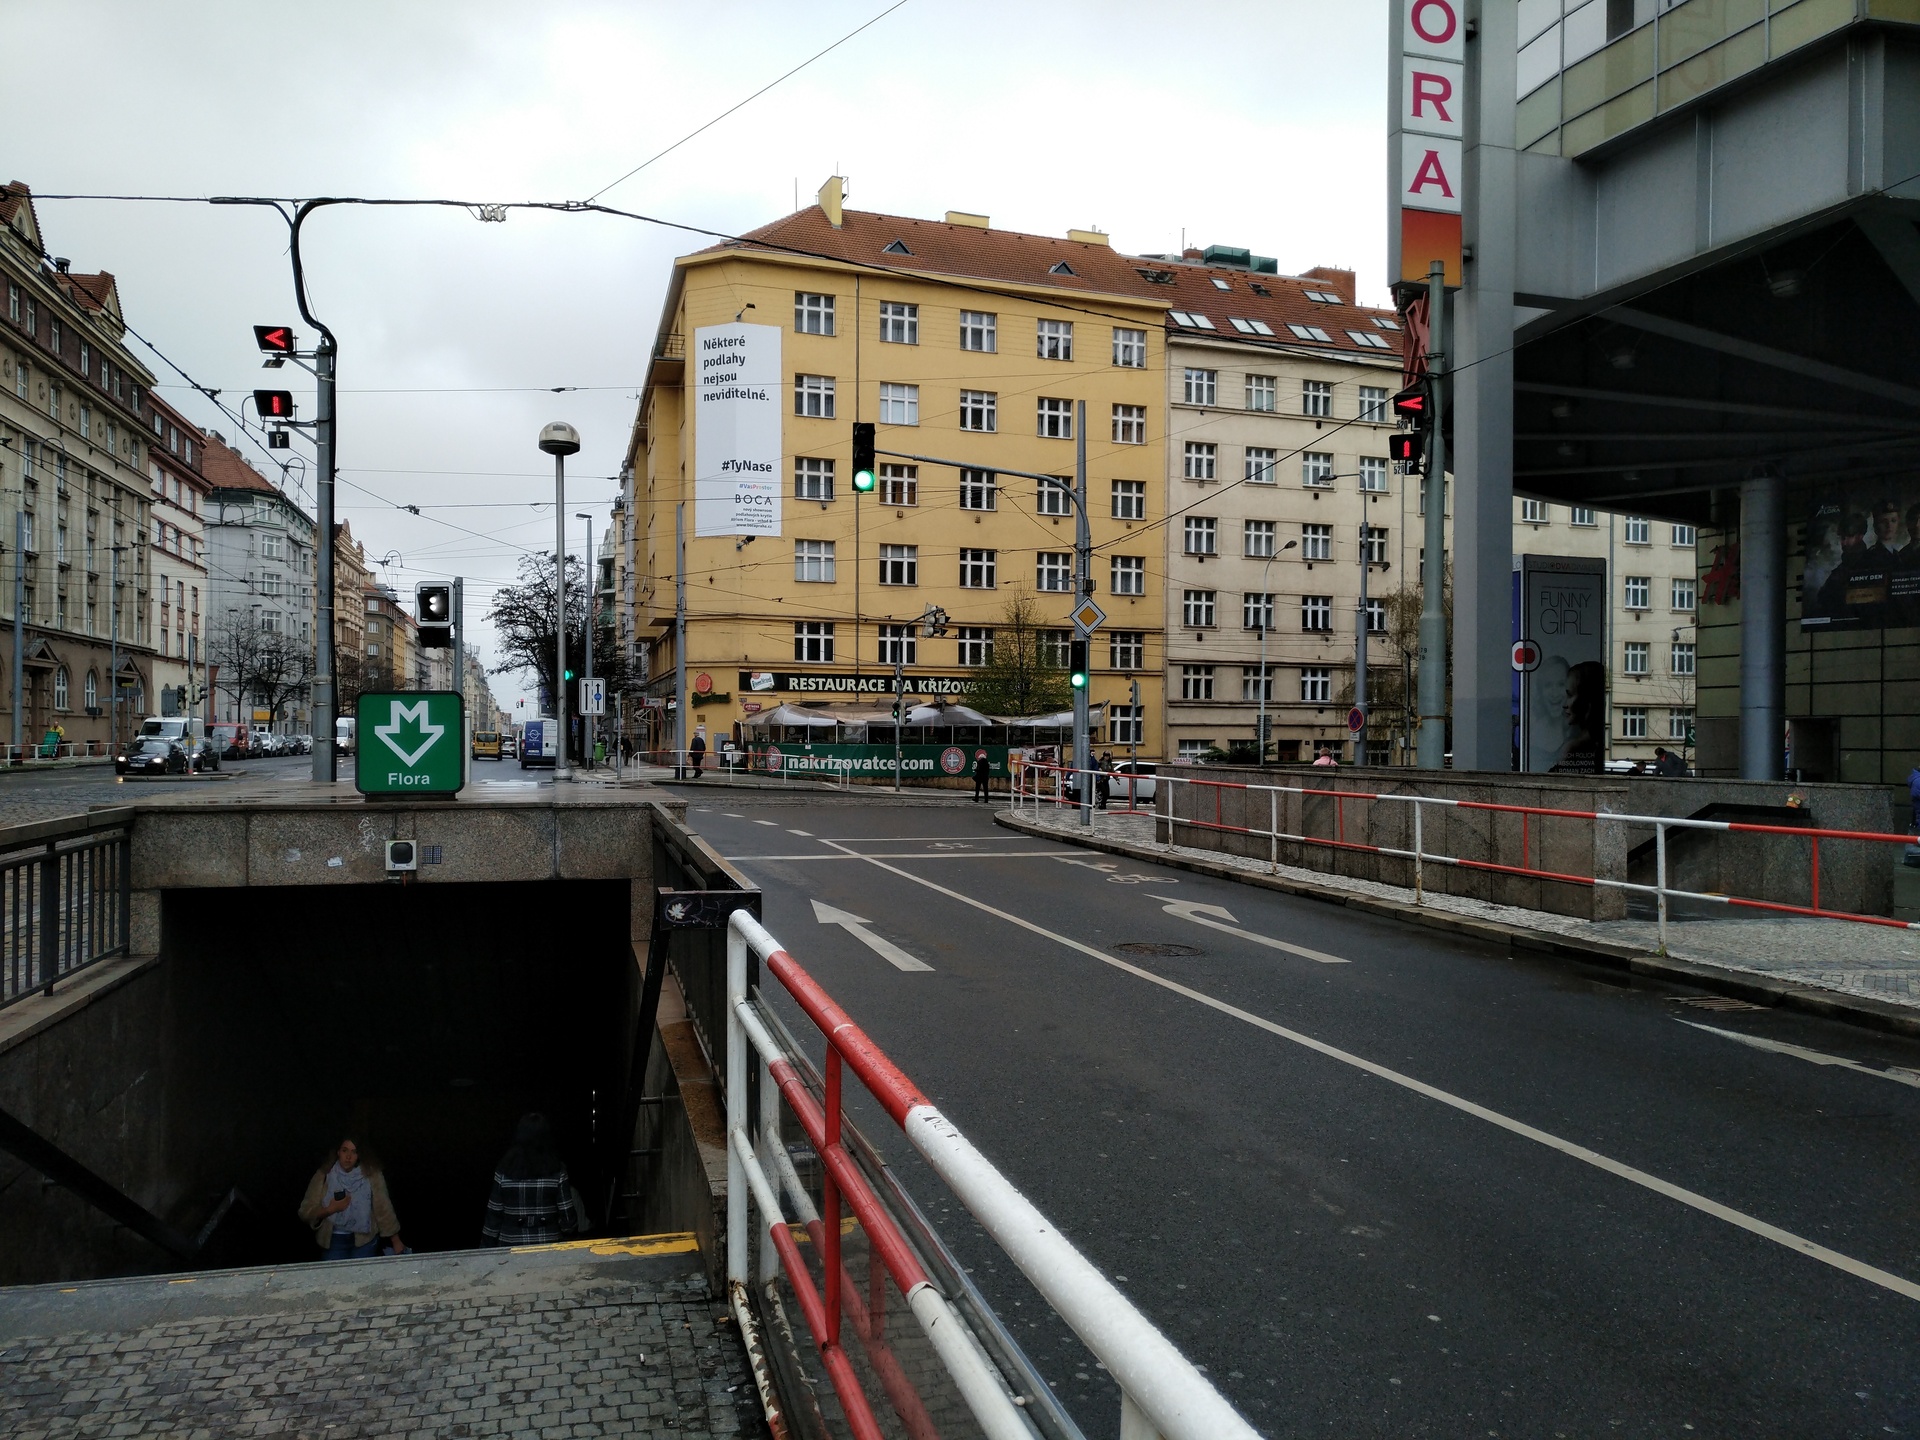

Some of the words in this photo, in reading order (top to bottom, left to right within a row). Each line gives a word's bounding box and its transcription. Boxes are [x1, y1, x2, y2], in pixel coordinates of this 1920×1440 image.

[1407, 0, 1457, 199] ORA
[703, 335, 746, 351] Některé
[703, 353, 746, 370] podlahy
[703, 372, 737, 386] nejsou
[703, 387, 770, 402] neviditelné.
[1411, 417, 1421, 431] L
[275, 434, 283, 448] P
[721, 459, 773, 473] #TyNase
[1406, 460, 1414, 475] P
[735, 494, 772, 506] BOCA
[1540, 591, 1592, 609] FUNNY
[1540, 608, 1592, 636] GIRL
[789, 677, 885, 693] RESTAURACE
[388, 772, 430, 785] Flora
